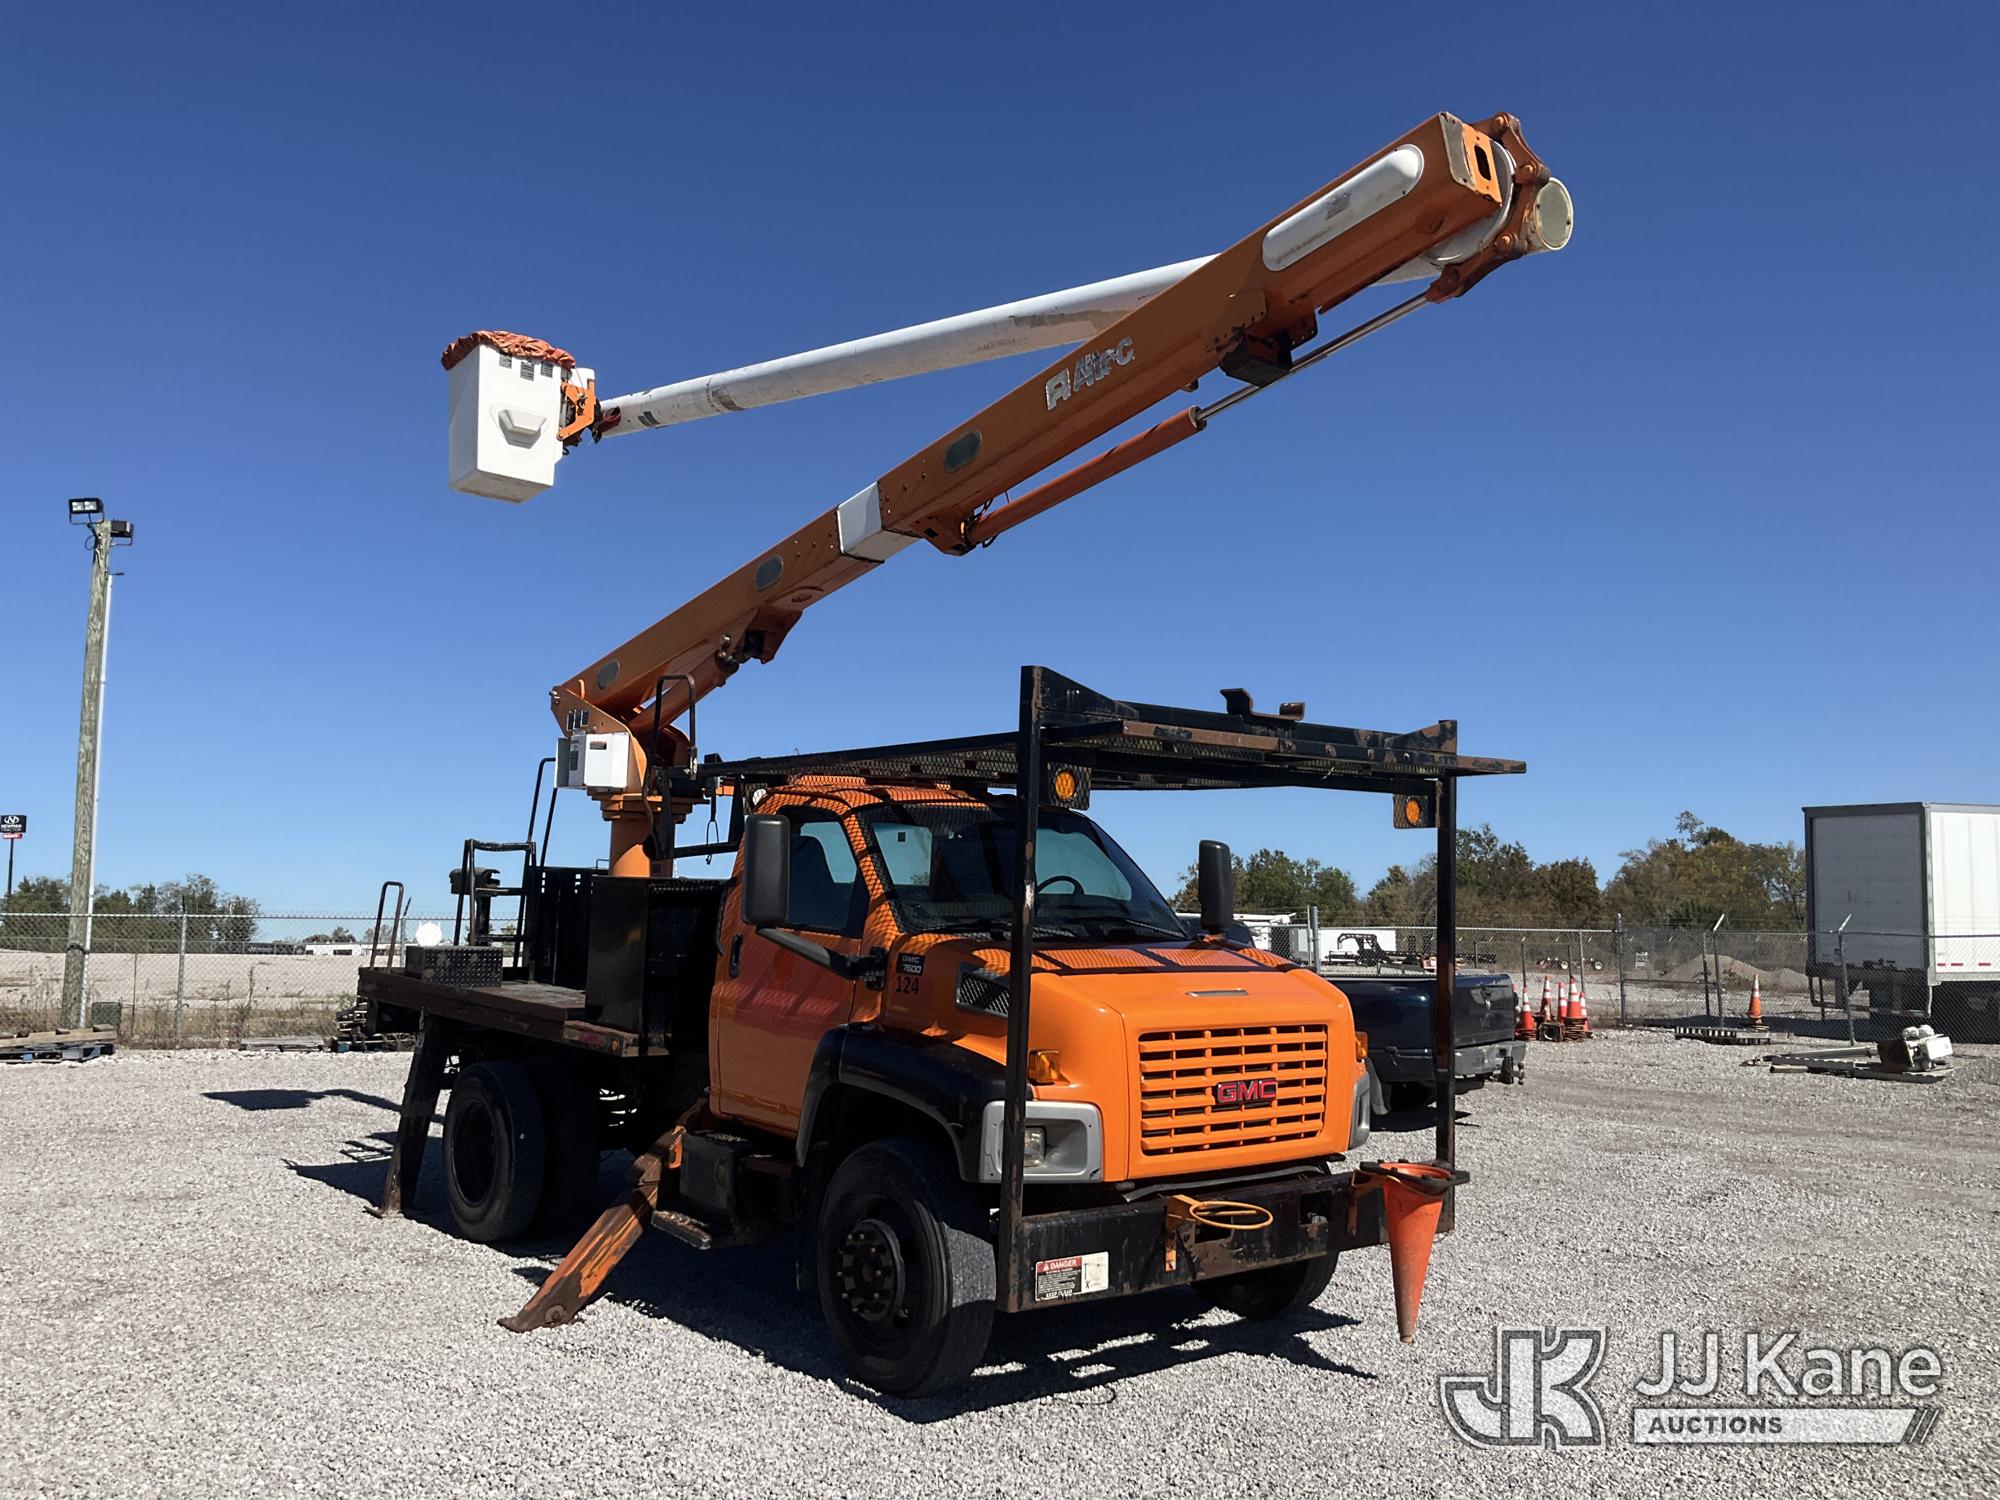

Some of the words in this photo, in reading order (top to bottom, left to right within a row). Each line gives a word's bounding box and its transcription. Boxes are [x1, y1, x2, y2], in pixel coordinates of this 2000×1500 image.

[902, 955, 920, 963] GMC
[903, 963, 922, 973] 7500
[895, 976, 920, 995] 124
[1218, 1079, 1277, 1103] GMC
[1050, 1259, 1077, 1270] DANGER
